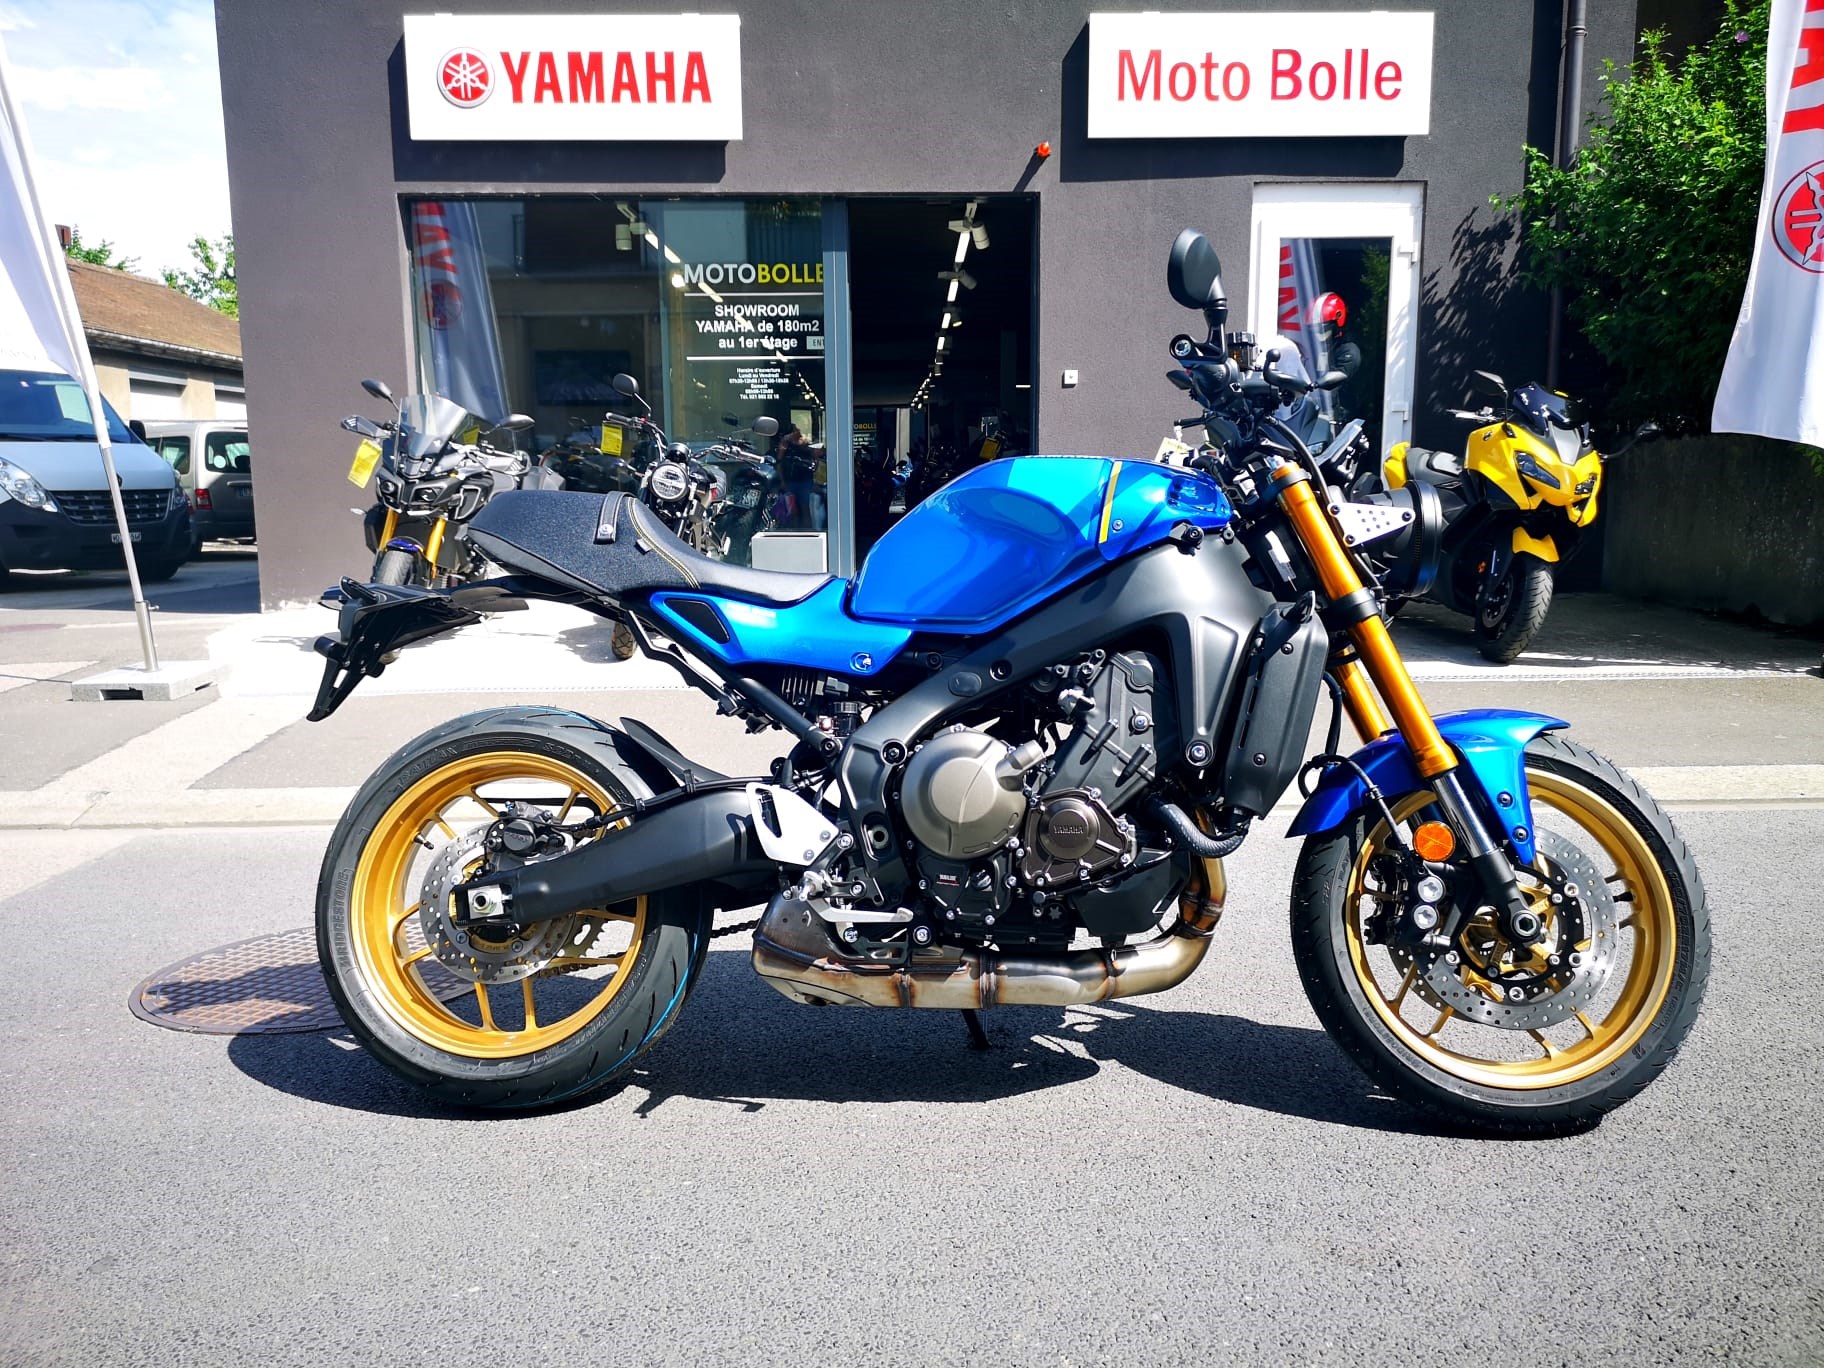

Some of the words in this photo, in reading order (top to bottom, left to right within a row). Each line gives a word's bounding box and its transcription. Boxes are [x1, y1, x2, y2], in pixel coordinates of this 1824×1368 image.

[499, 51, 712, 104] YAMAHA
[1117, 49, 1251, 102] Moto
[1270, 48, 1403, 101] Bolle
[714, 304, 800, 317] SHOWROOM
[695, 320, 755, 333] YAMAHA
[757, 320, 774, 332] de
[777, 319, 820, 332] 180m2
[718, 337, 735, 349] au
[738, 335, 758, 349] 1er
